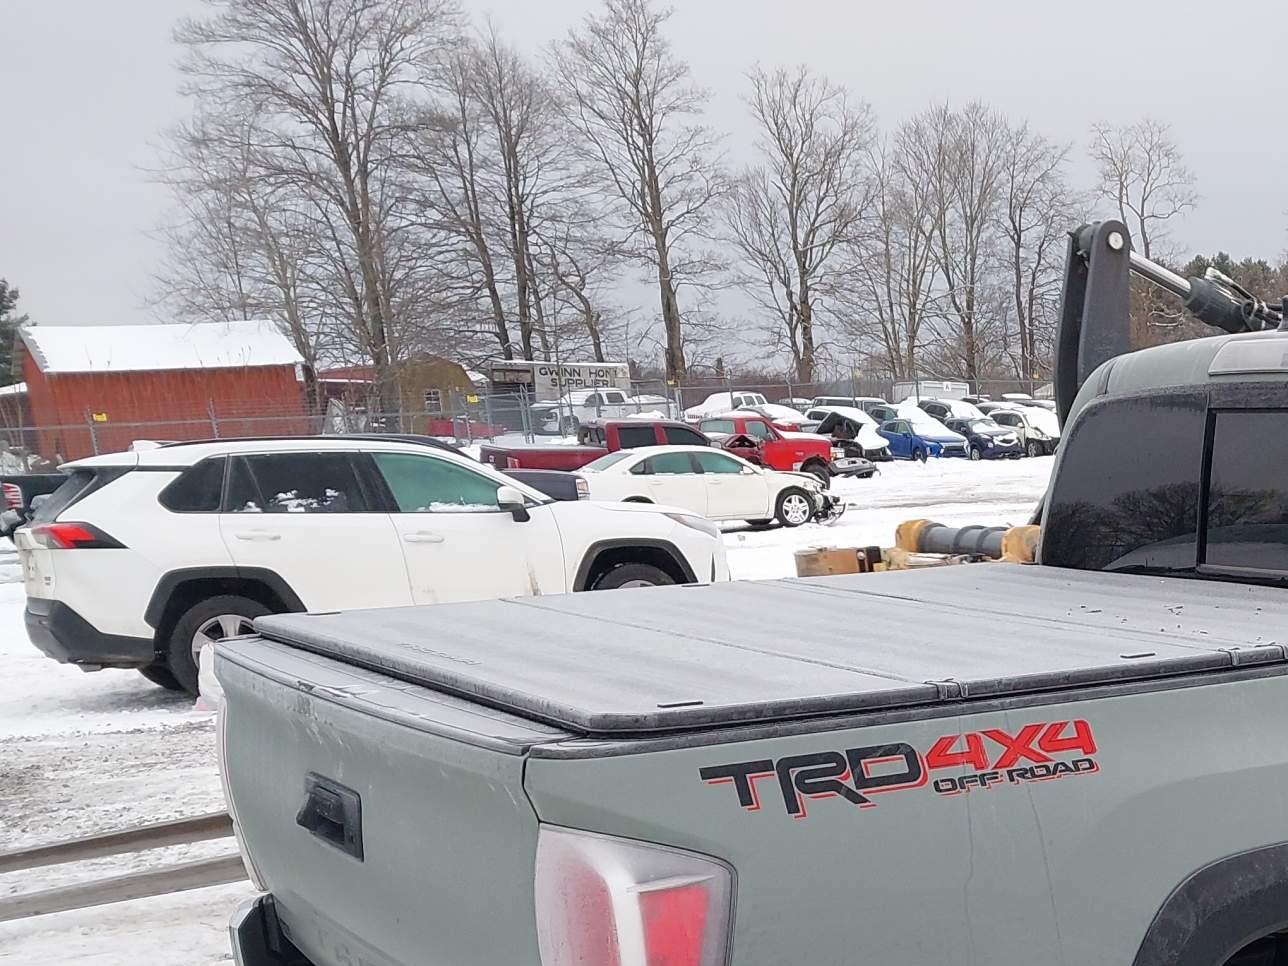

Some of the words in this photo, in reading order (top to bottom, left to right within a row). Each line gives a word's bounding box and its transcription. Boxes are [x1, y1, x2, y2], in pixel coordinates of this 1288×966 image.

[539, 366, 581, 377] GWINN
[699, 742, 928, 818] TRD
[925, 719, 1098, 771] 4X4
[933, 772, 1000, 795] OFF
[1006, 757, 1100, 783] ROAD
